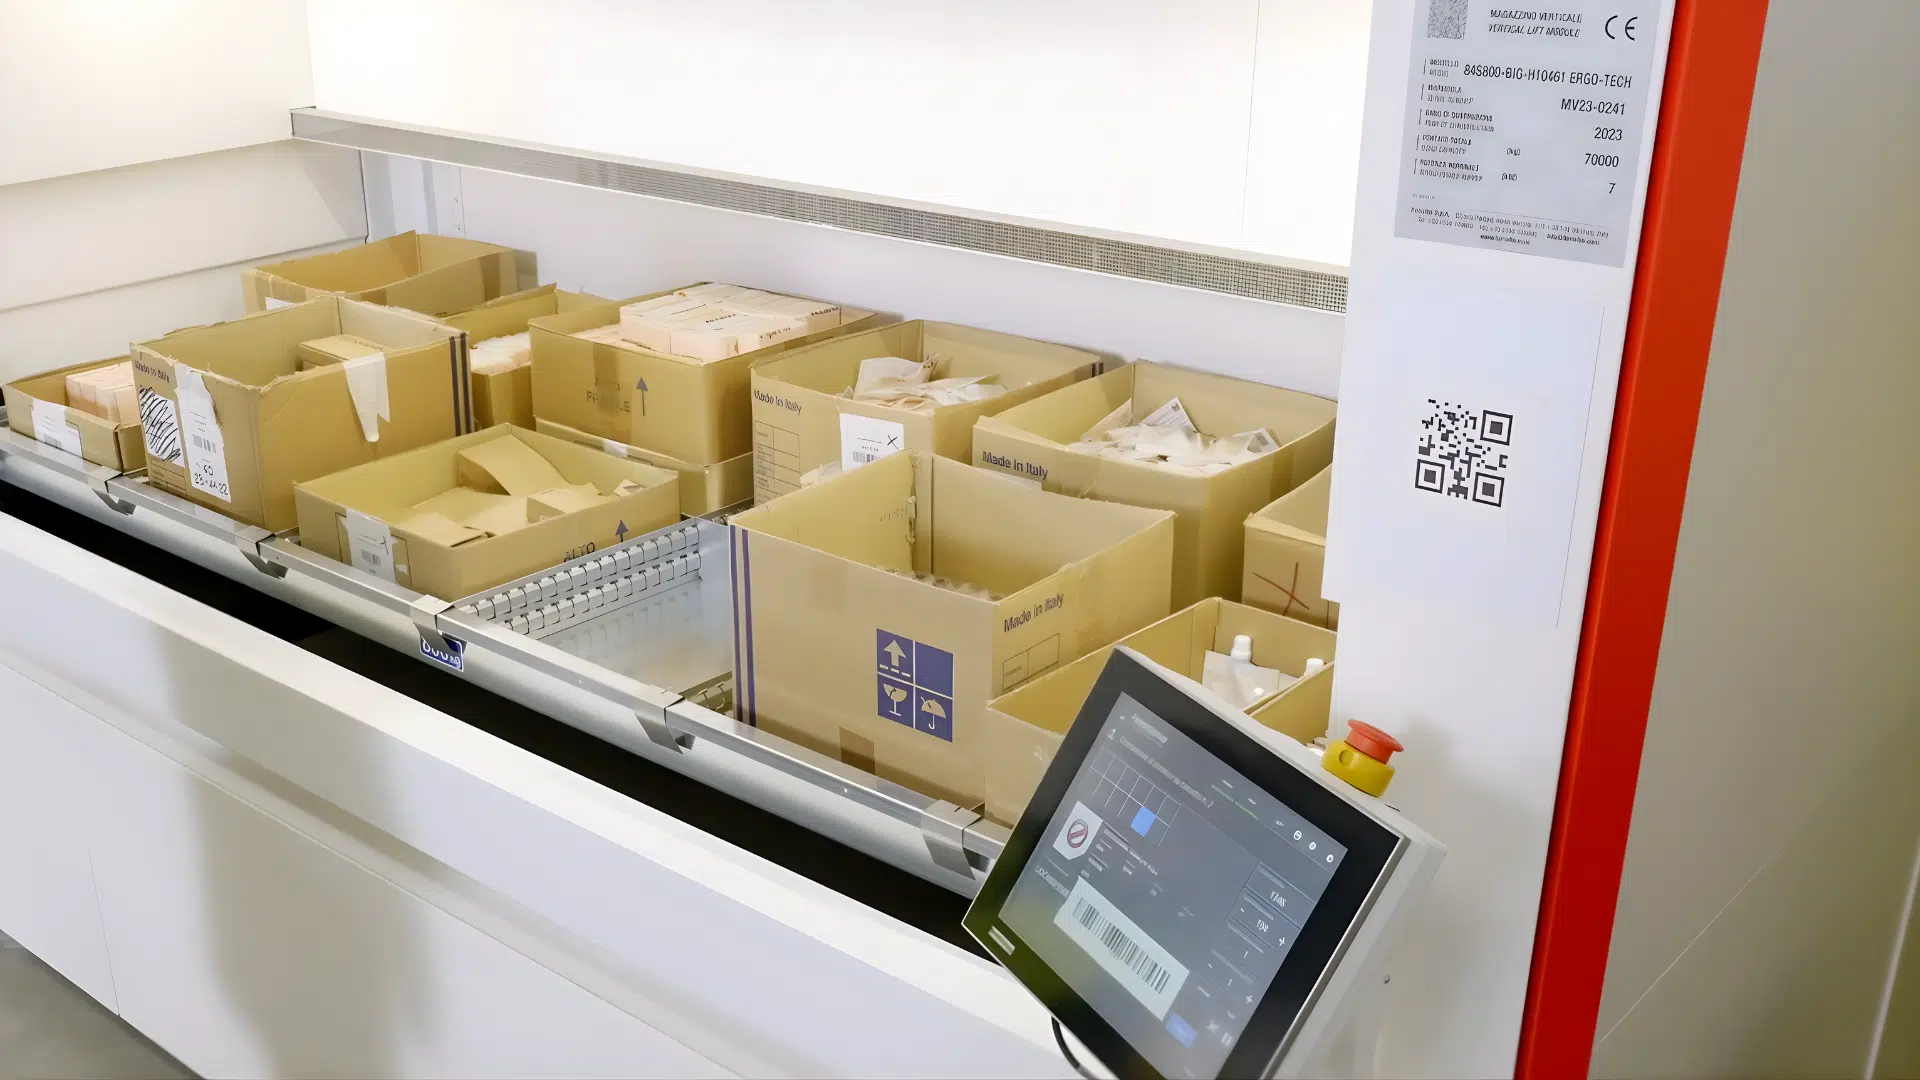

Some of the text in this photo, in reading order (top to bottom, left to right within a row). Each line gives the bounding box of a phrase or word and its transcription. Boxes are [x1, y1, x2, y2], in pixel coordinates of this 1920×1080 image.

[1569, 71, 1633, 88] ERGO-TECH
[1560, 98, 1626, 116] MV23-0241
[1594, 126, 1623, 141] 2023
[1584, 153, 1620, 168] 70000
[1608, 182, 1616, 194] 7
[982, 451, 1012, 469] Made
[1026, 462, 1049, 481] Italy
[1003, 609, 1032, 633] Made
